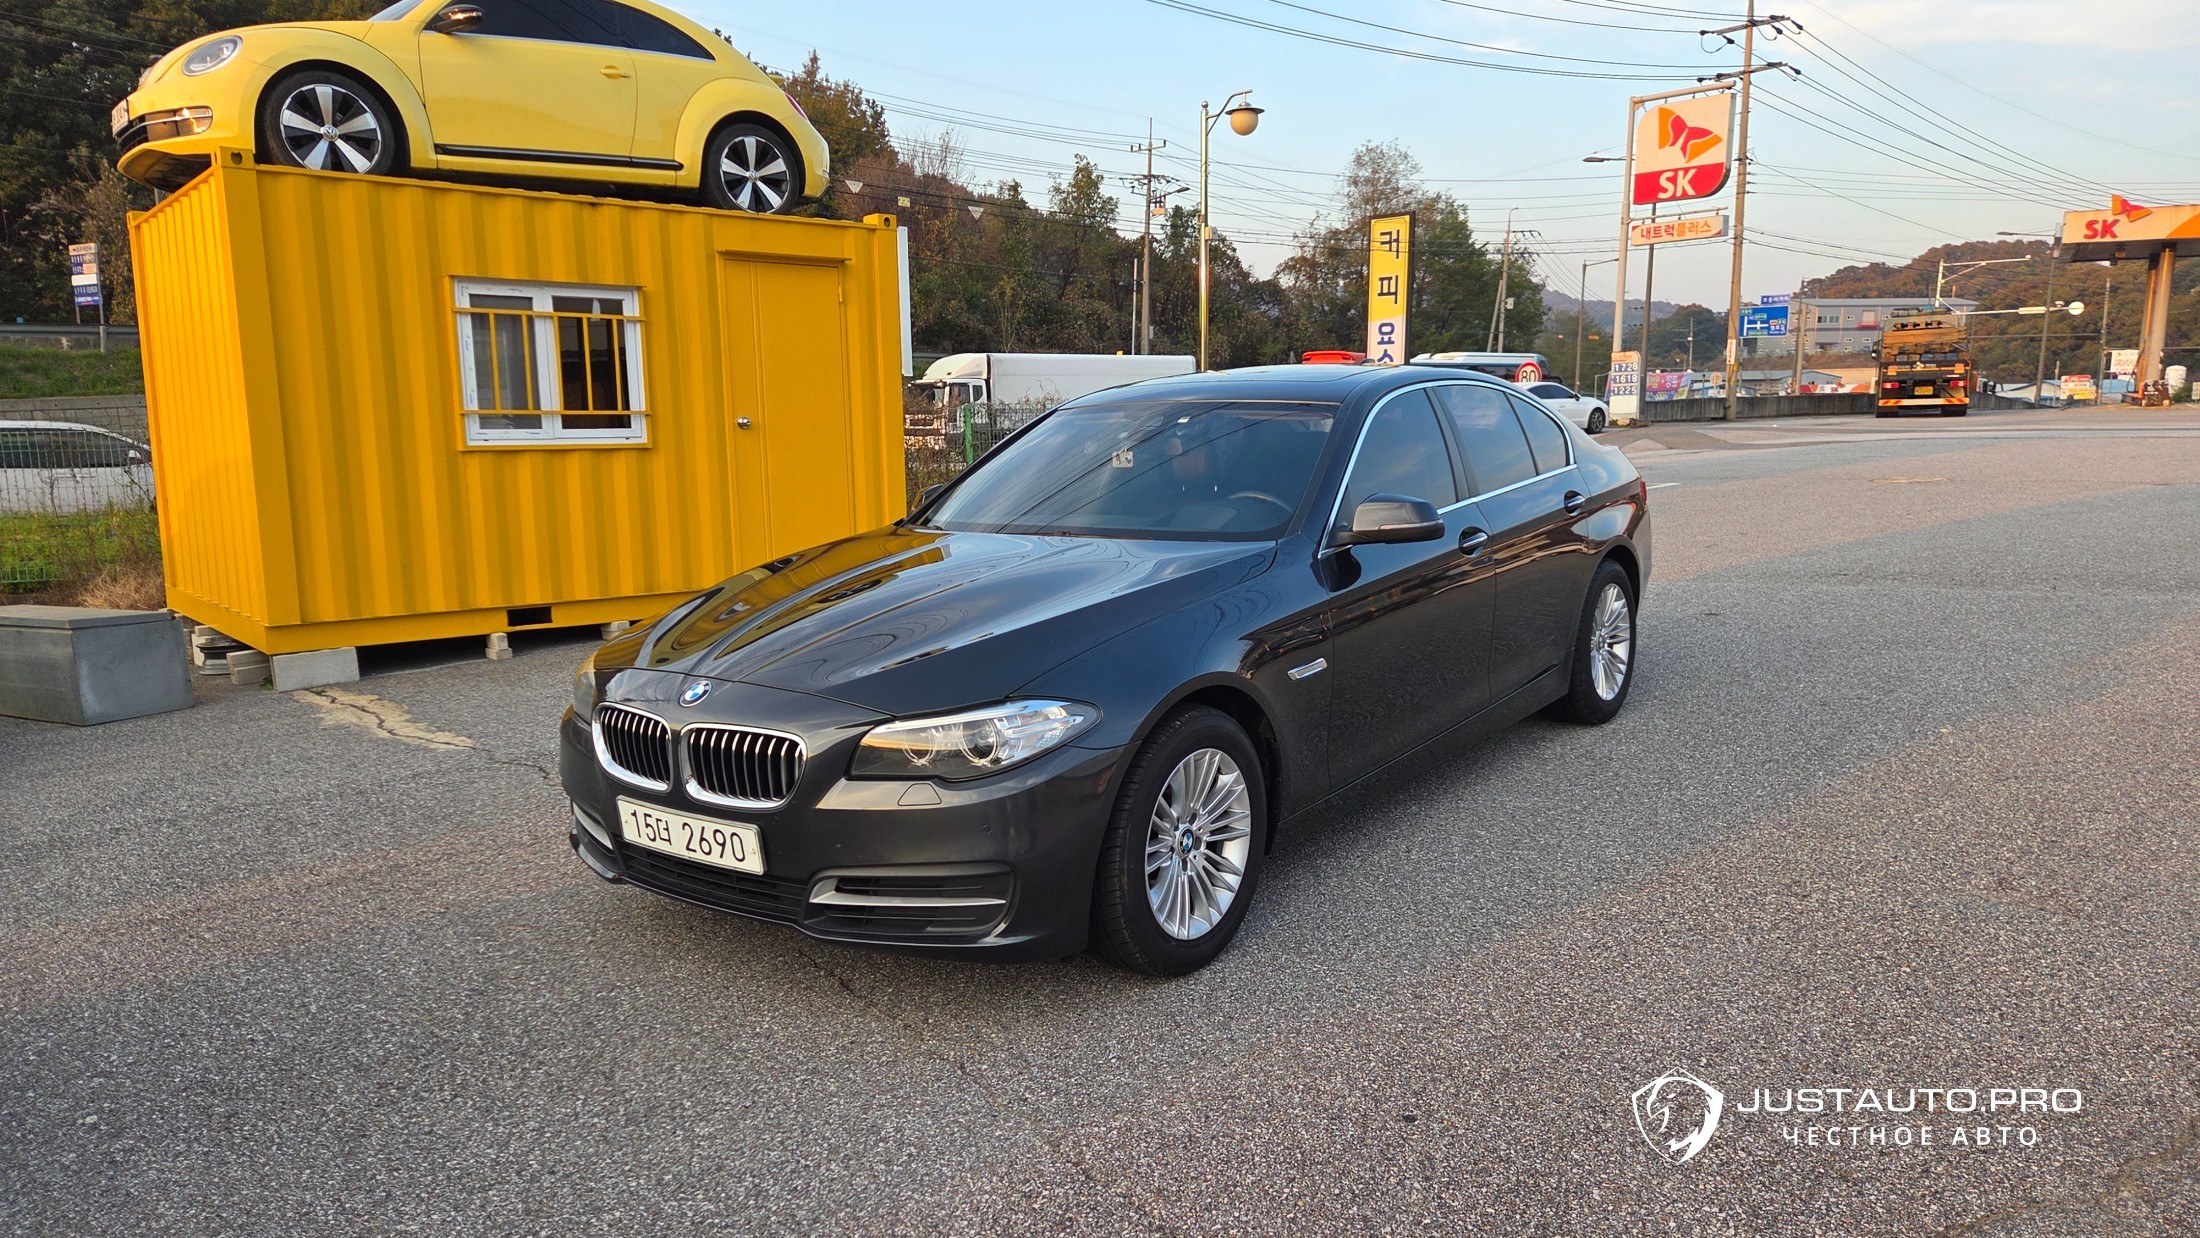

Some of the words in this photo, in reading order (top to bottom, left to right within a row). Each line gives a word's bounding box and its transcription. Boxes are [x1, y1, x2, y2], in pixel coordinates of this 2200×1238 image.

[1657, 168, 1698, 199] SK
[1640, 220, 1712, 241] 내트럭플러스
[2083, 219, 2121, 240] SK
[1377, 229, 1400, 305] 커피
[1520, 370, 1537, 383] 80
[1615, 362, 1639, 372] 1728
[1616, 374, 1638, 384] 1618
[1613, 385, 1638, 395] 1225
[630, 808, 671, 847] 15더
[682, 821, 746, 863] 2690
